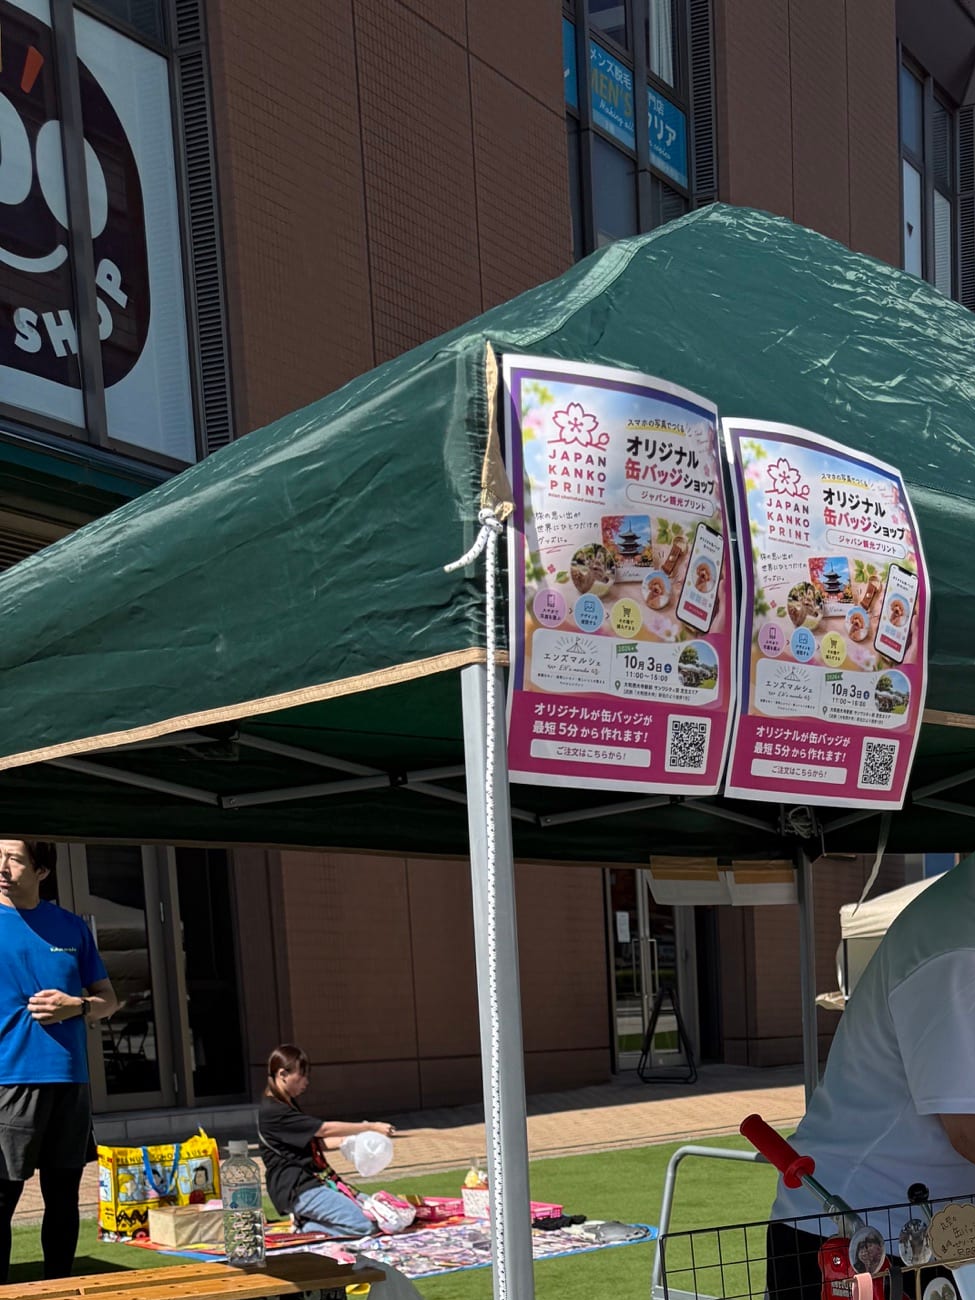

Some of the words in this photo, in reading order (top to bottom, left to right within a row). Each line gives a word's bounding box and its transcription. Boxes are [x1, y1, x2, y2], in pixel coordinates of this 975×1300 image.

[627, 419, 685, 433] スマホの写真でつくる
[548, 449, 607, 467] JAPAN
[626, 436, 699, 469] オリジナル
[548, 465, 607, 483] KANKO
[624, 458, 715, 495] 缶バッジショップ
[550, 480, 605, 498] PRINT
[641, 491, 706, 511] ジャパン観光プリント
[767, 498, 809, 515] JAPAN
[823, 488, 886, 518] オリジナル
[535, 511, 581, 521] 旅の思い出が
[767, 511, 810, 528] KANKO
[823, 507, 906, 540] 缶バッジショップ
[537, 522, 599, 533] 世界にひとつだけの
[769, 525, 810, 542] PRINT
[839, 535, 897, 554] ジャパン観光プリント
[544, 654, 600, 666] エンズマルシェ
[765, 680, 813, 694] エンズマルシェ
[534, 703, 653, 726] オリジナルが缶バッジが
[756, 725, 851, 746] オリジナルが缶バッジが
